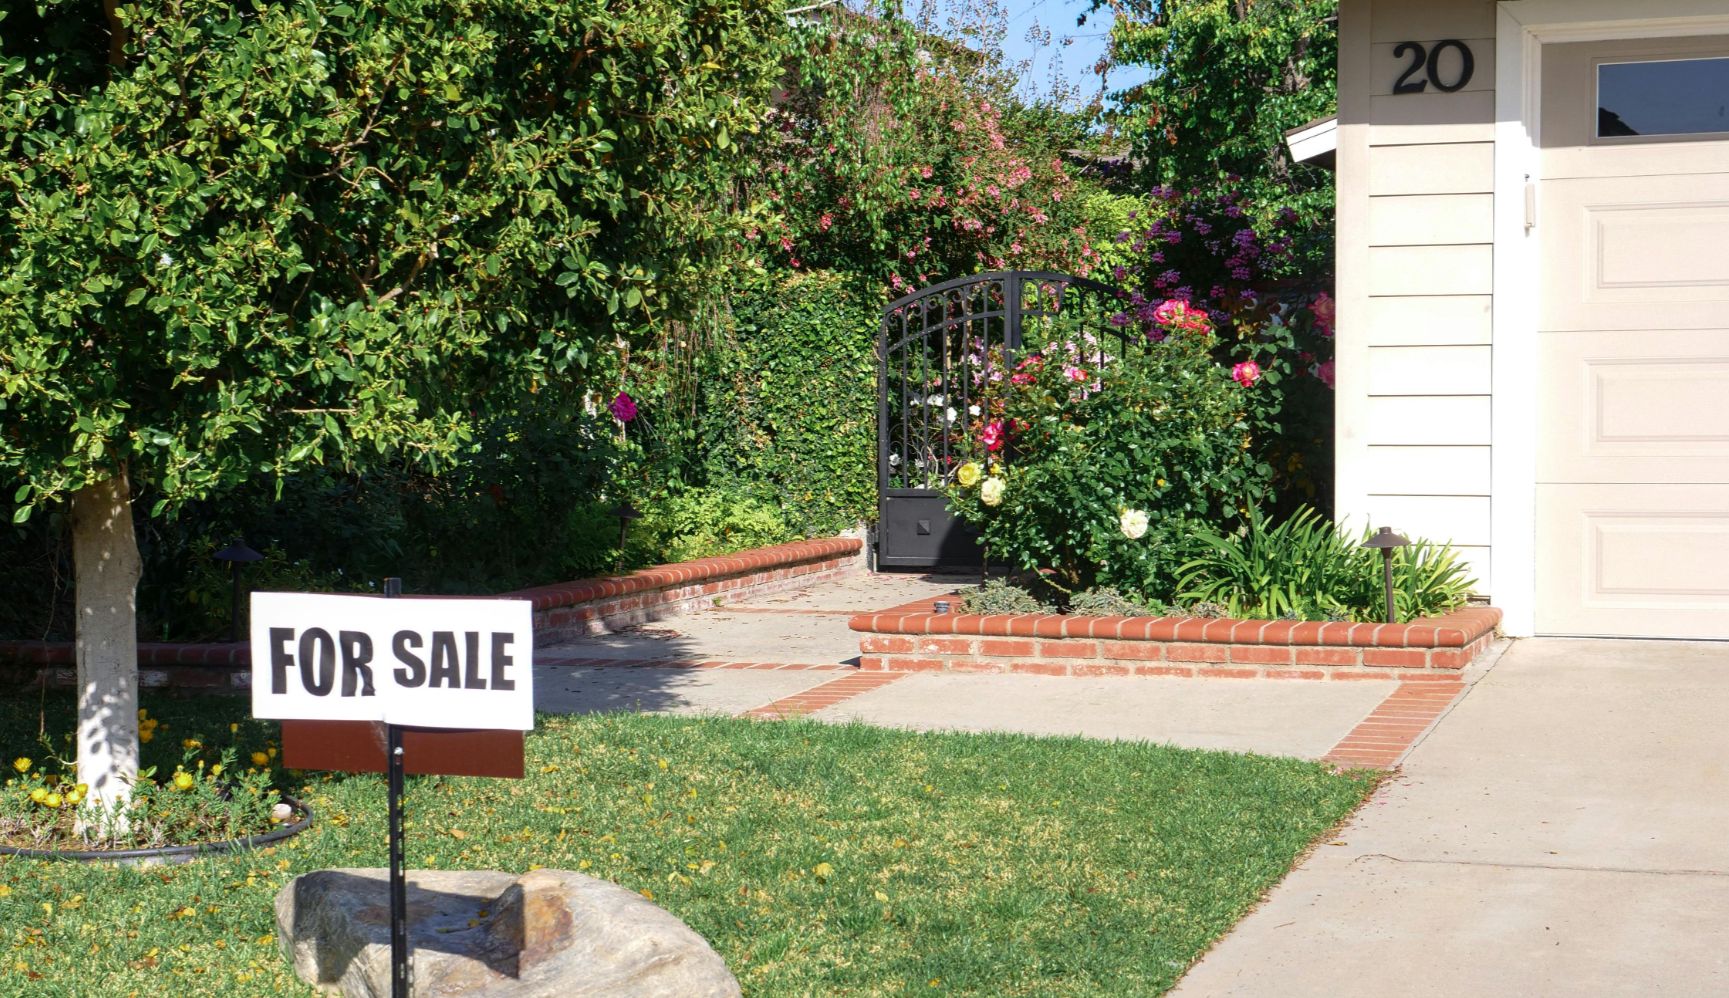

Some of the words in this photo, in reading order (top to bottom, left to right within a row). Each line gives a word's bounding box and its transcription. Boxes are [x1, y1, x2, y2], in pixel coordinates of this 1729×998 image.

[1393, 38, 1475, 95] 20
[269, 627, 376, 697] FOR
[392, 629, 516, 691] SALE
